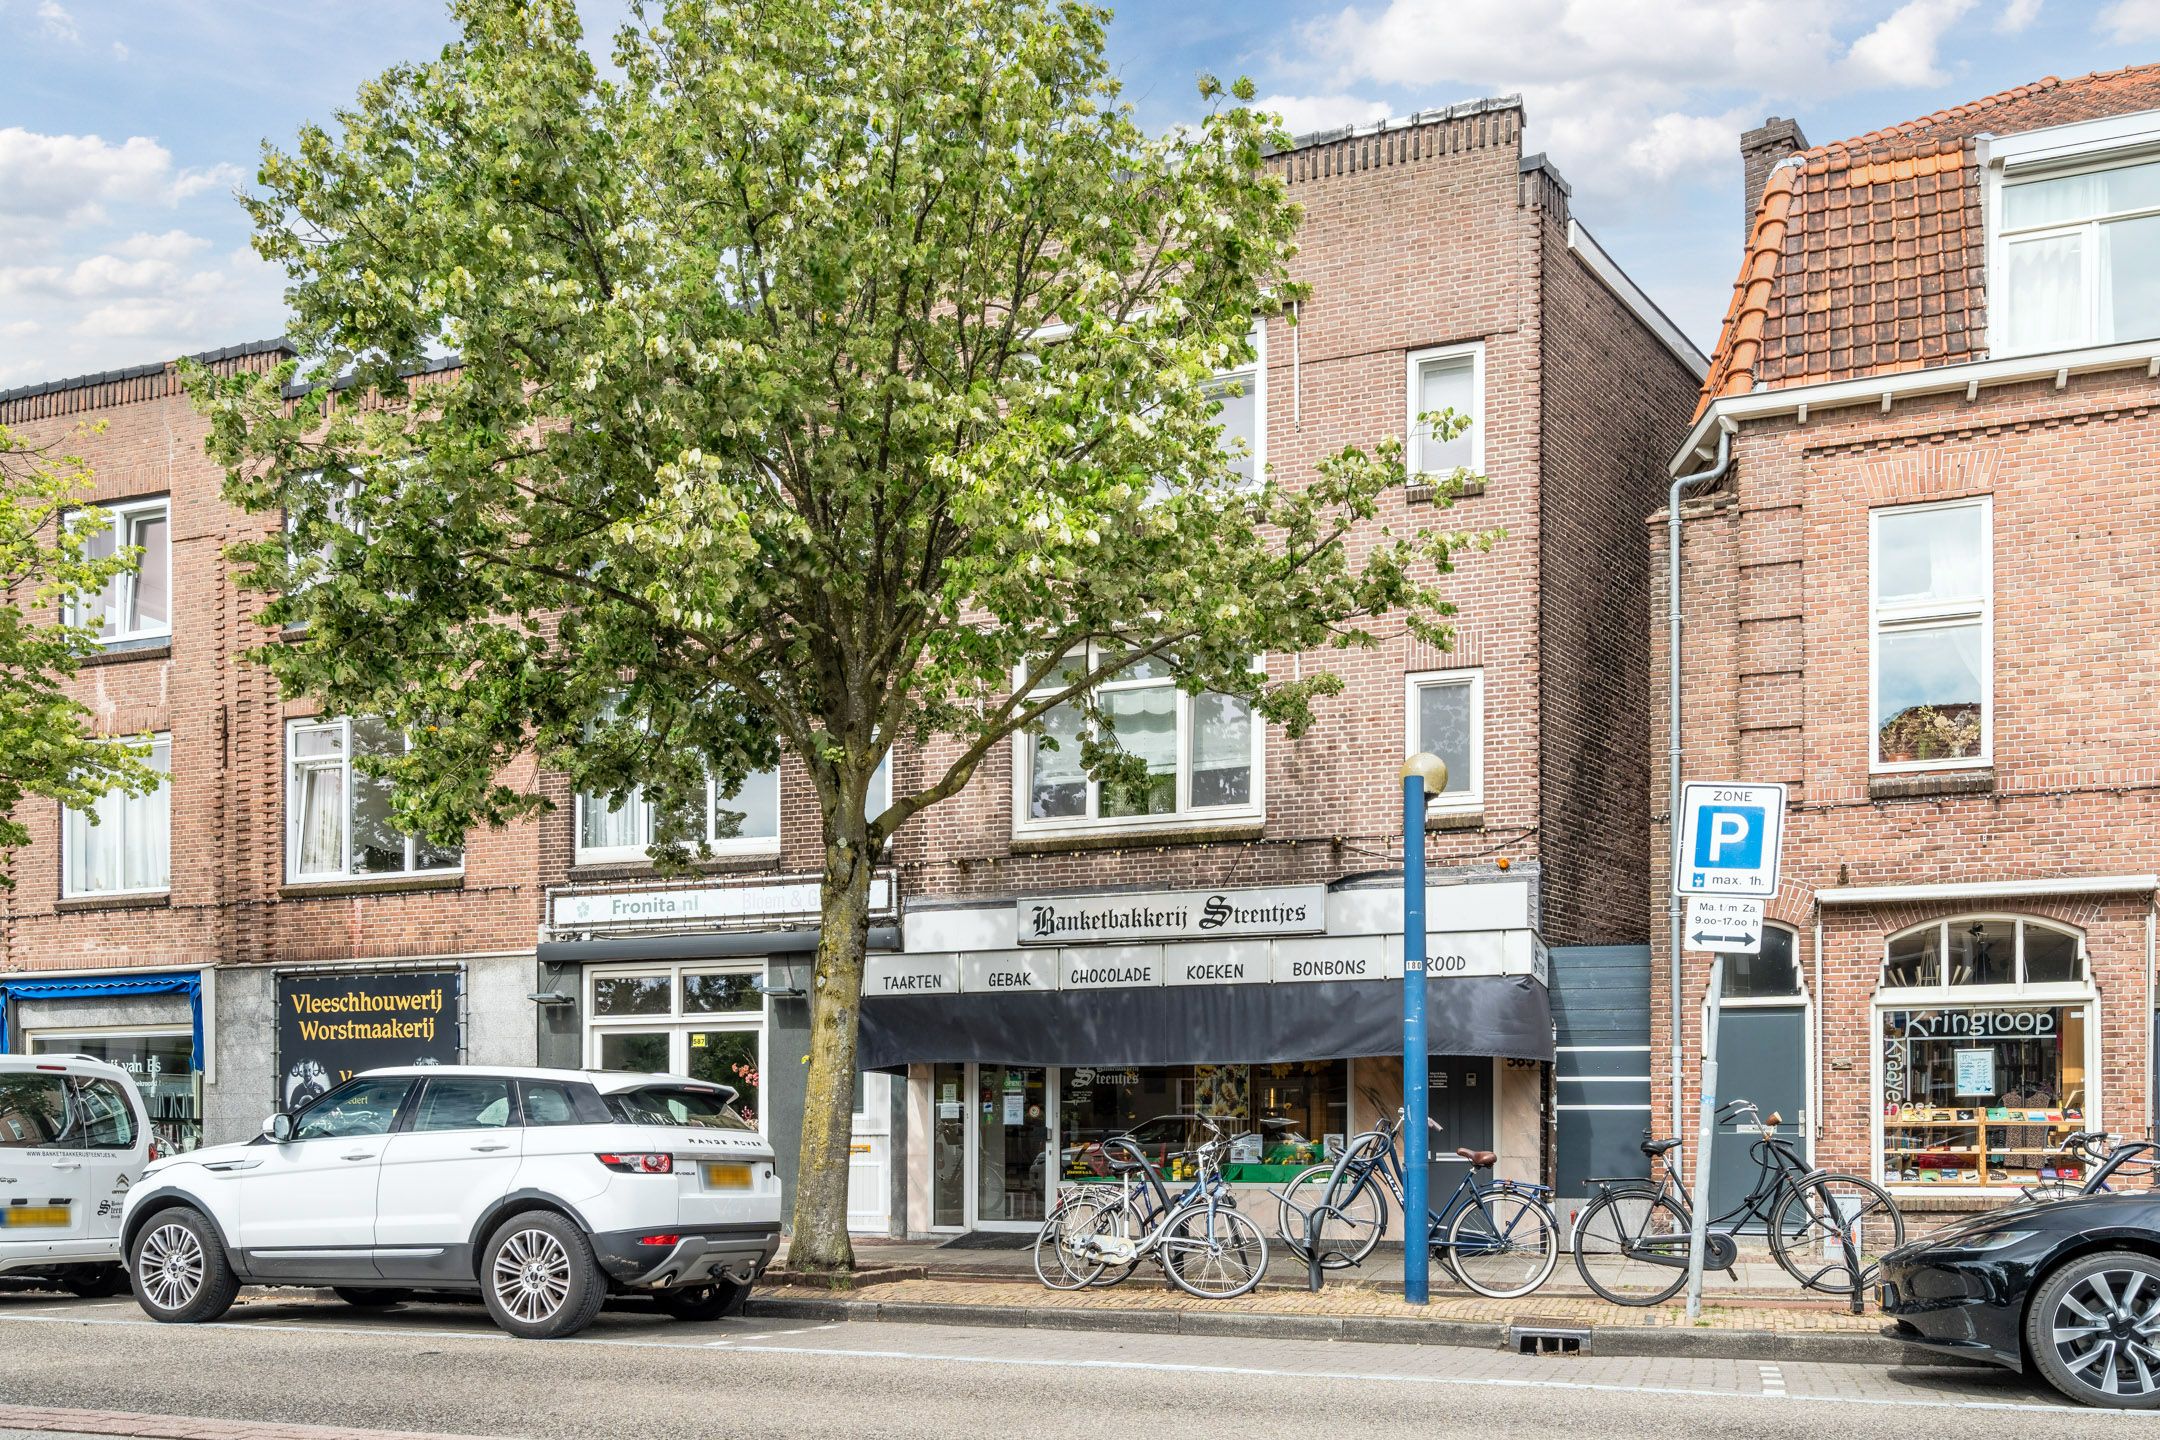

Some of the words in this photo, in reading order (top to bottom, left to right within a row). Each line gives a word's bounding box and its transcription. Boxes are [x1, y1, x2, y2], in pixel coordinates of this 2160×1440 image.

[1713, 790, 1753, 802] ZONE
[1708, 812, 1749, 862] P
[1711, 876, 1742, 886] max.
[1749, 876, 1765, 887] 1h.
[1032, 905, 1188, 937] Banketbakkerij
[1198, 895, 1307, 930] Steentjes
[1699, 902, 1716, 911] Ma.
[1719, 904, 1738, 912] t/m
[1742, 904, 1758, 913] Za.
[1752, 919, 1759, 927] h
[1186, 963, 1244, 980] KOEKEN
[1292, 959, 1366, 976] BONBONS
[1407, 961, 1422, 970] 180
[1426, 955, 1466, 971] ROOD
[883, 974, 942, 990] TAARTEN
[988, 972, 1032, 987] GEBAK
[1071, 967, 1151, 984] CHOCOLADE
[291, 988, 443, 1014] Vleeschhouwerij
[299, 1017, 436, 1042] Worstmaakerij
[1904, 1009, 2054, 1037] Kringloop
[1071, 1066, 1140, 1087] Steentjes
